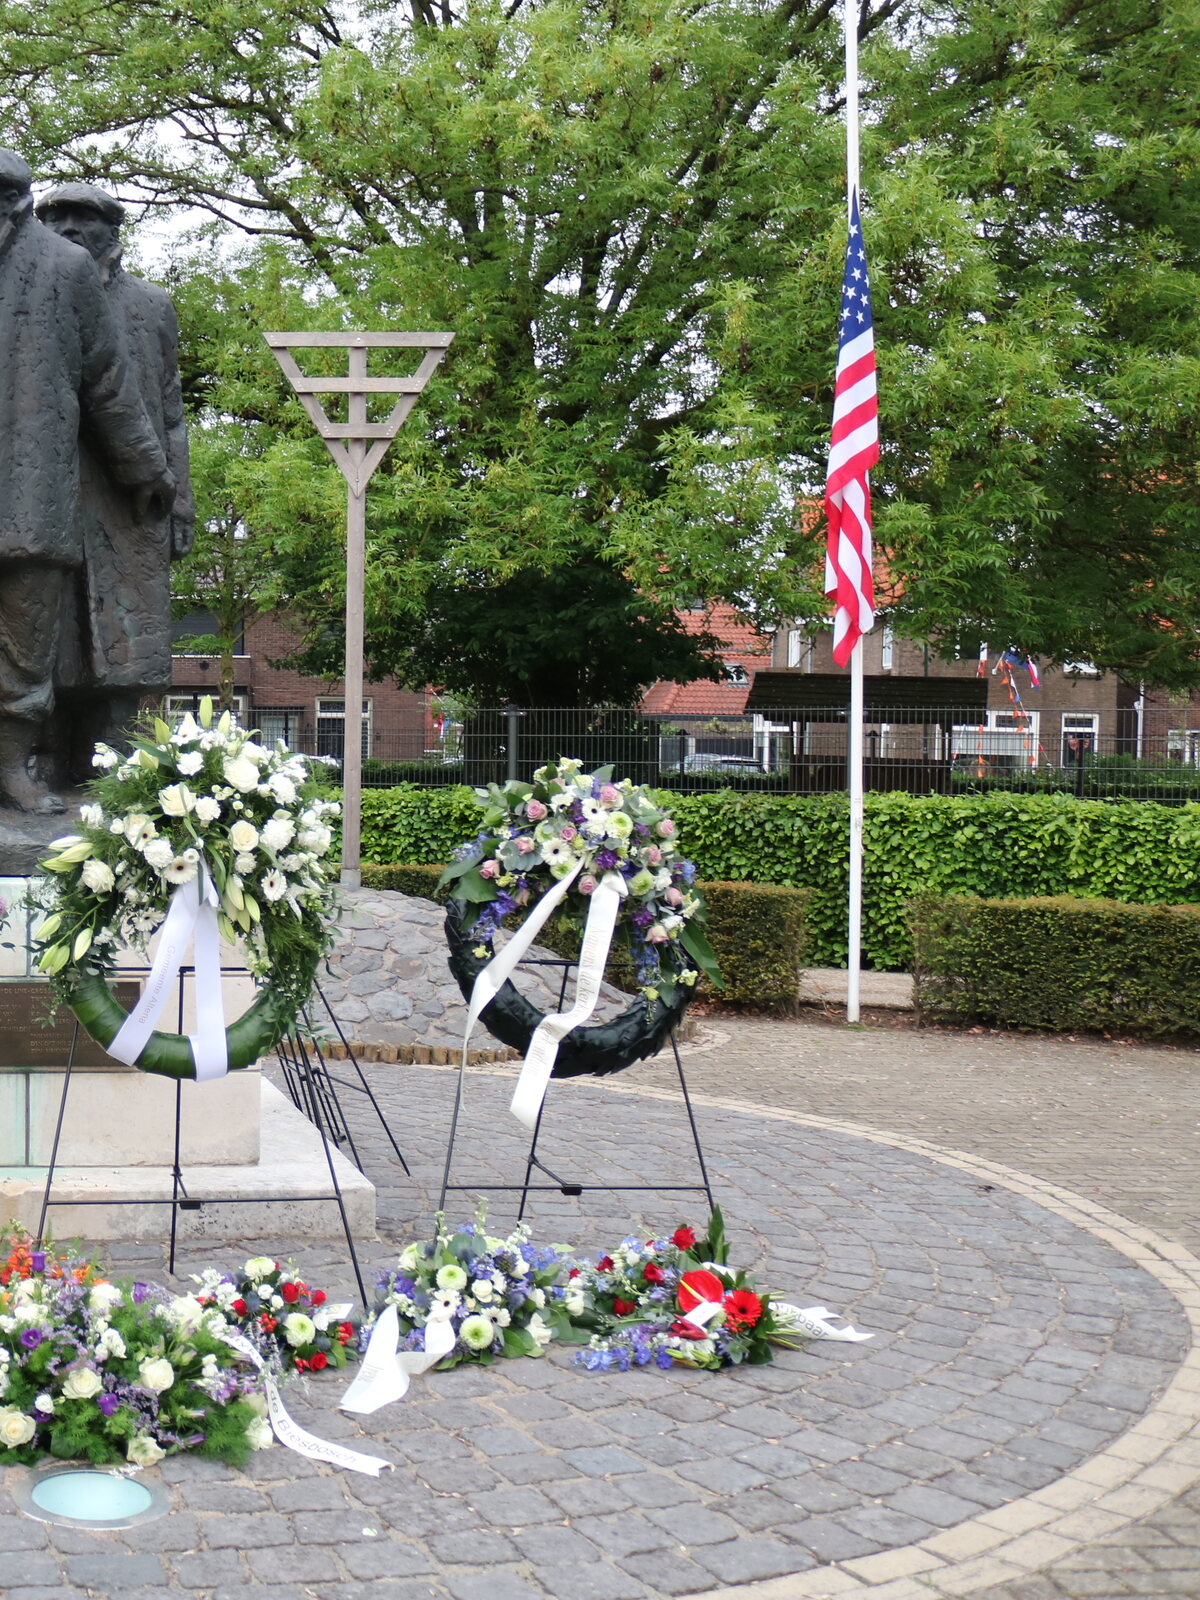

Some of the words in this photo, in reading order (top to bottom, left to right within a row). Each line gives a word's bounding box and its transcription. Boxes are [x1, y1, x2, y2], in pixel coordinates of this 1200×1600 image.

[586, 927, 599, 969] Namens
[152, 945, 176, 994] Gemeente
[582, 970, 599, 984] de
[137, 994, 159, 1025] Altena
[277, 1420, 357, 1464] Biesbosch
